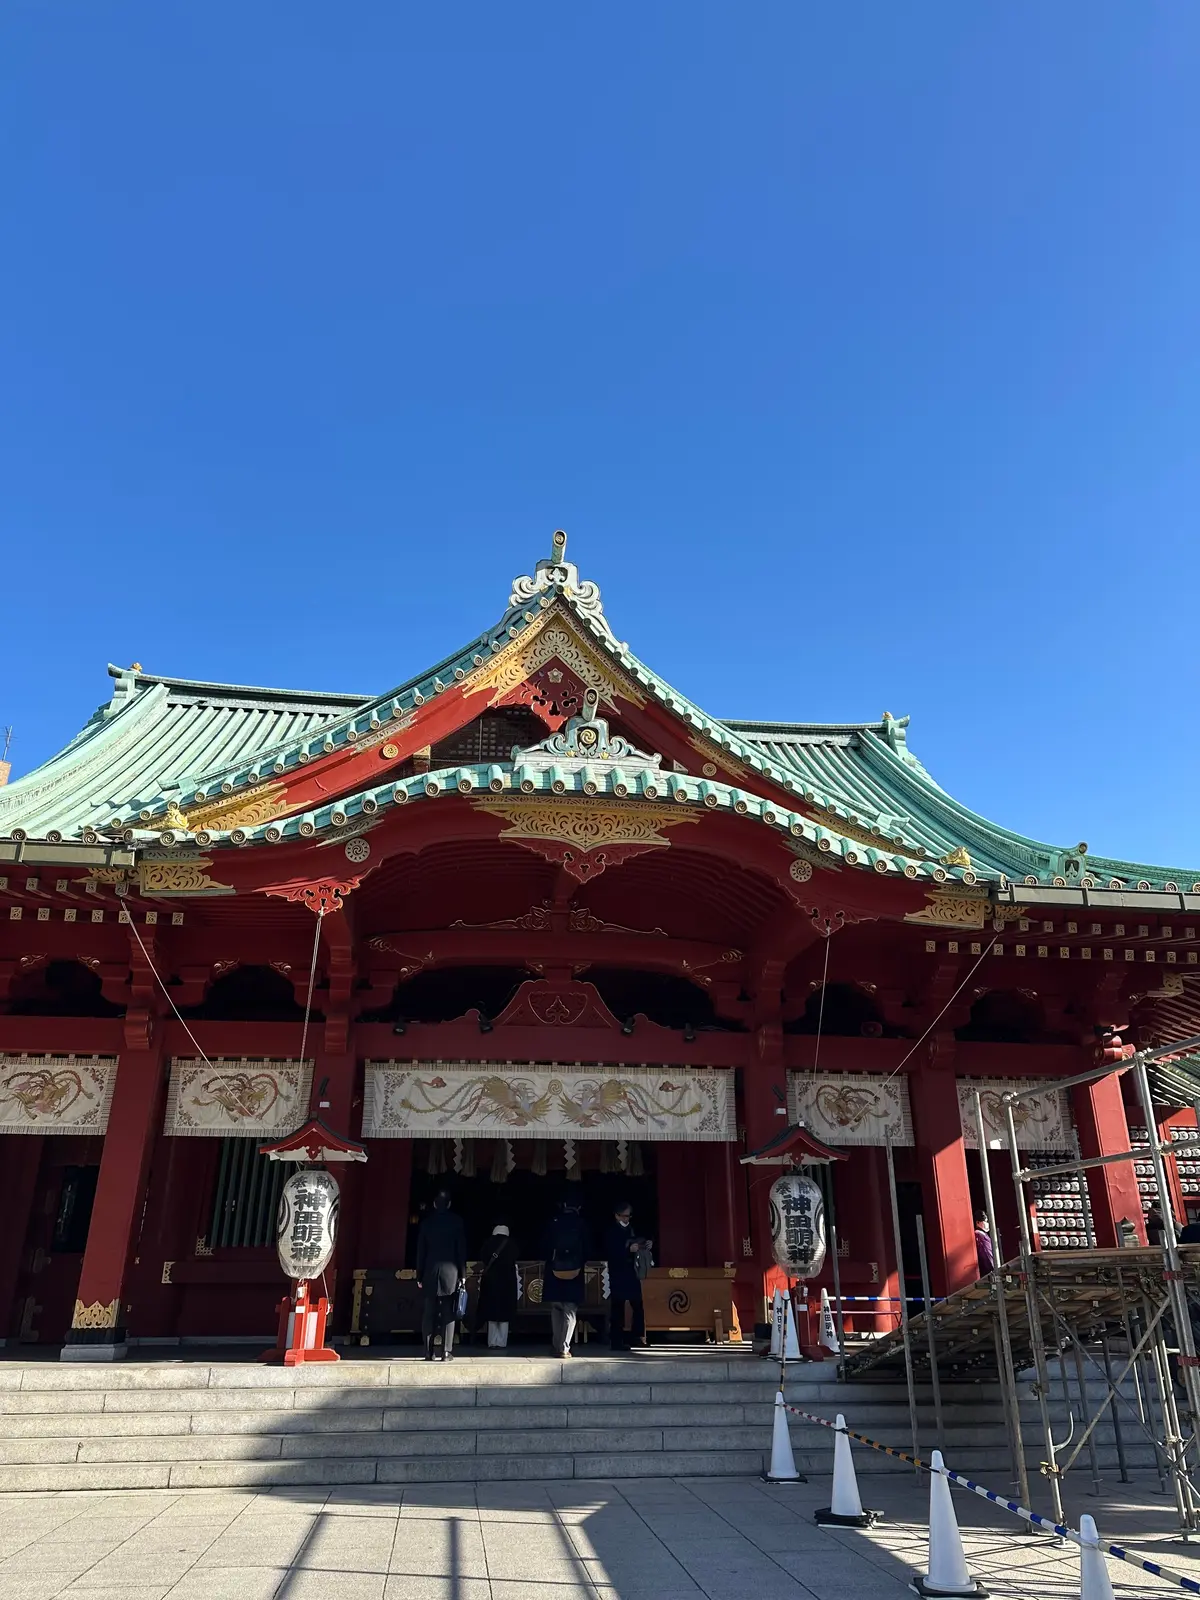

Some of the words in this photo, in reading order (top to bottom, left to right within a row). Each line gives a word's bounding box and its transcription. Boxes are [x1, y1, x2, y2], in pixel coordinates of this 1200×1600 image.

[290, 1188, 327, 1262] 神田明神
[781, 1194, 816, 1264] 神田明神
